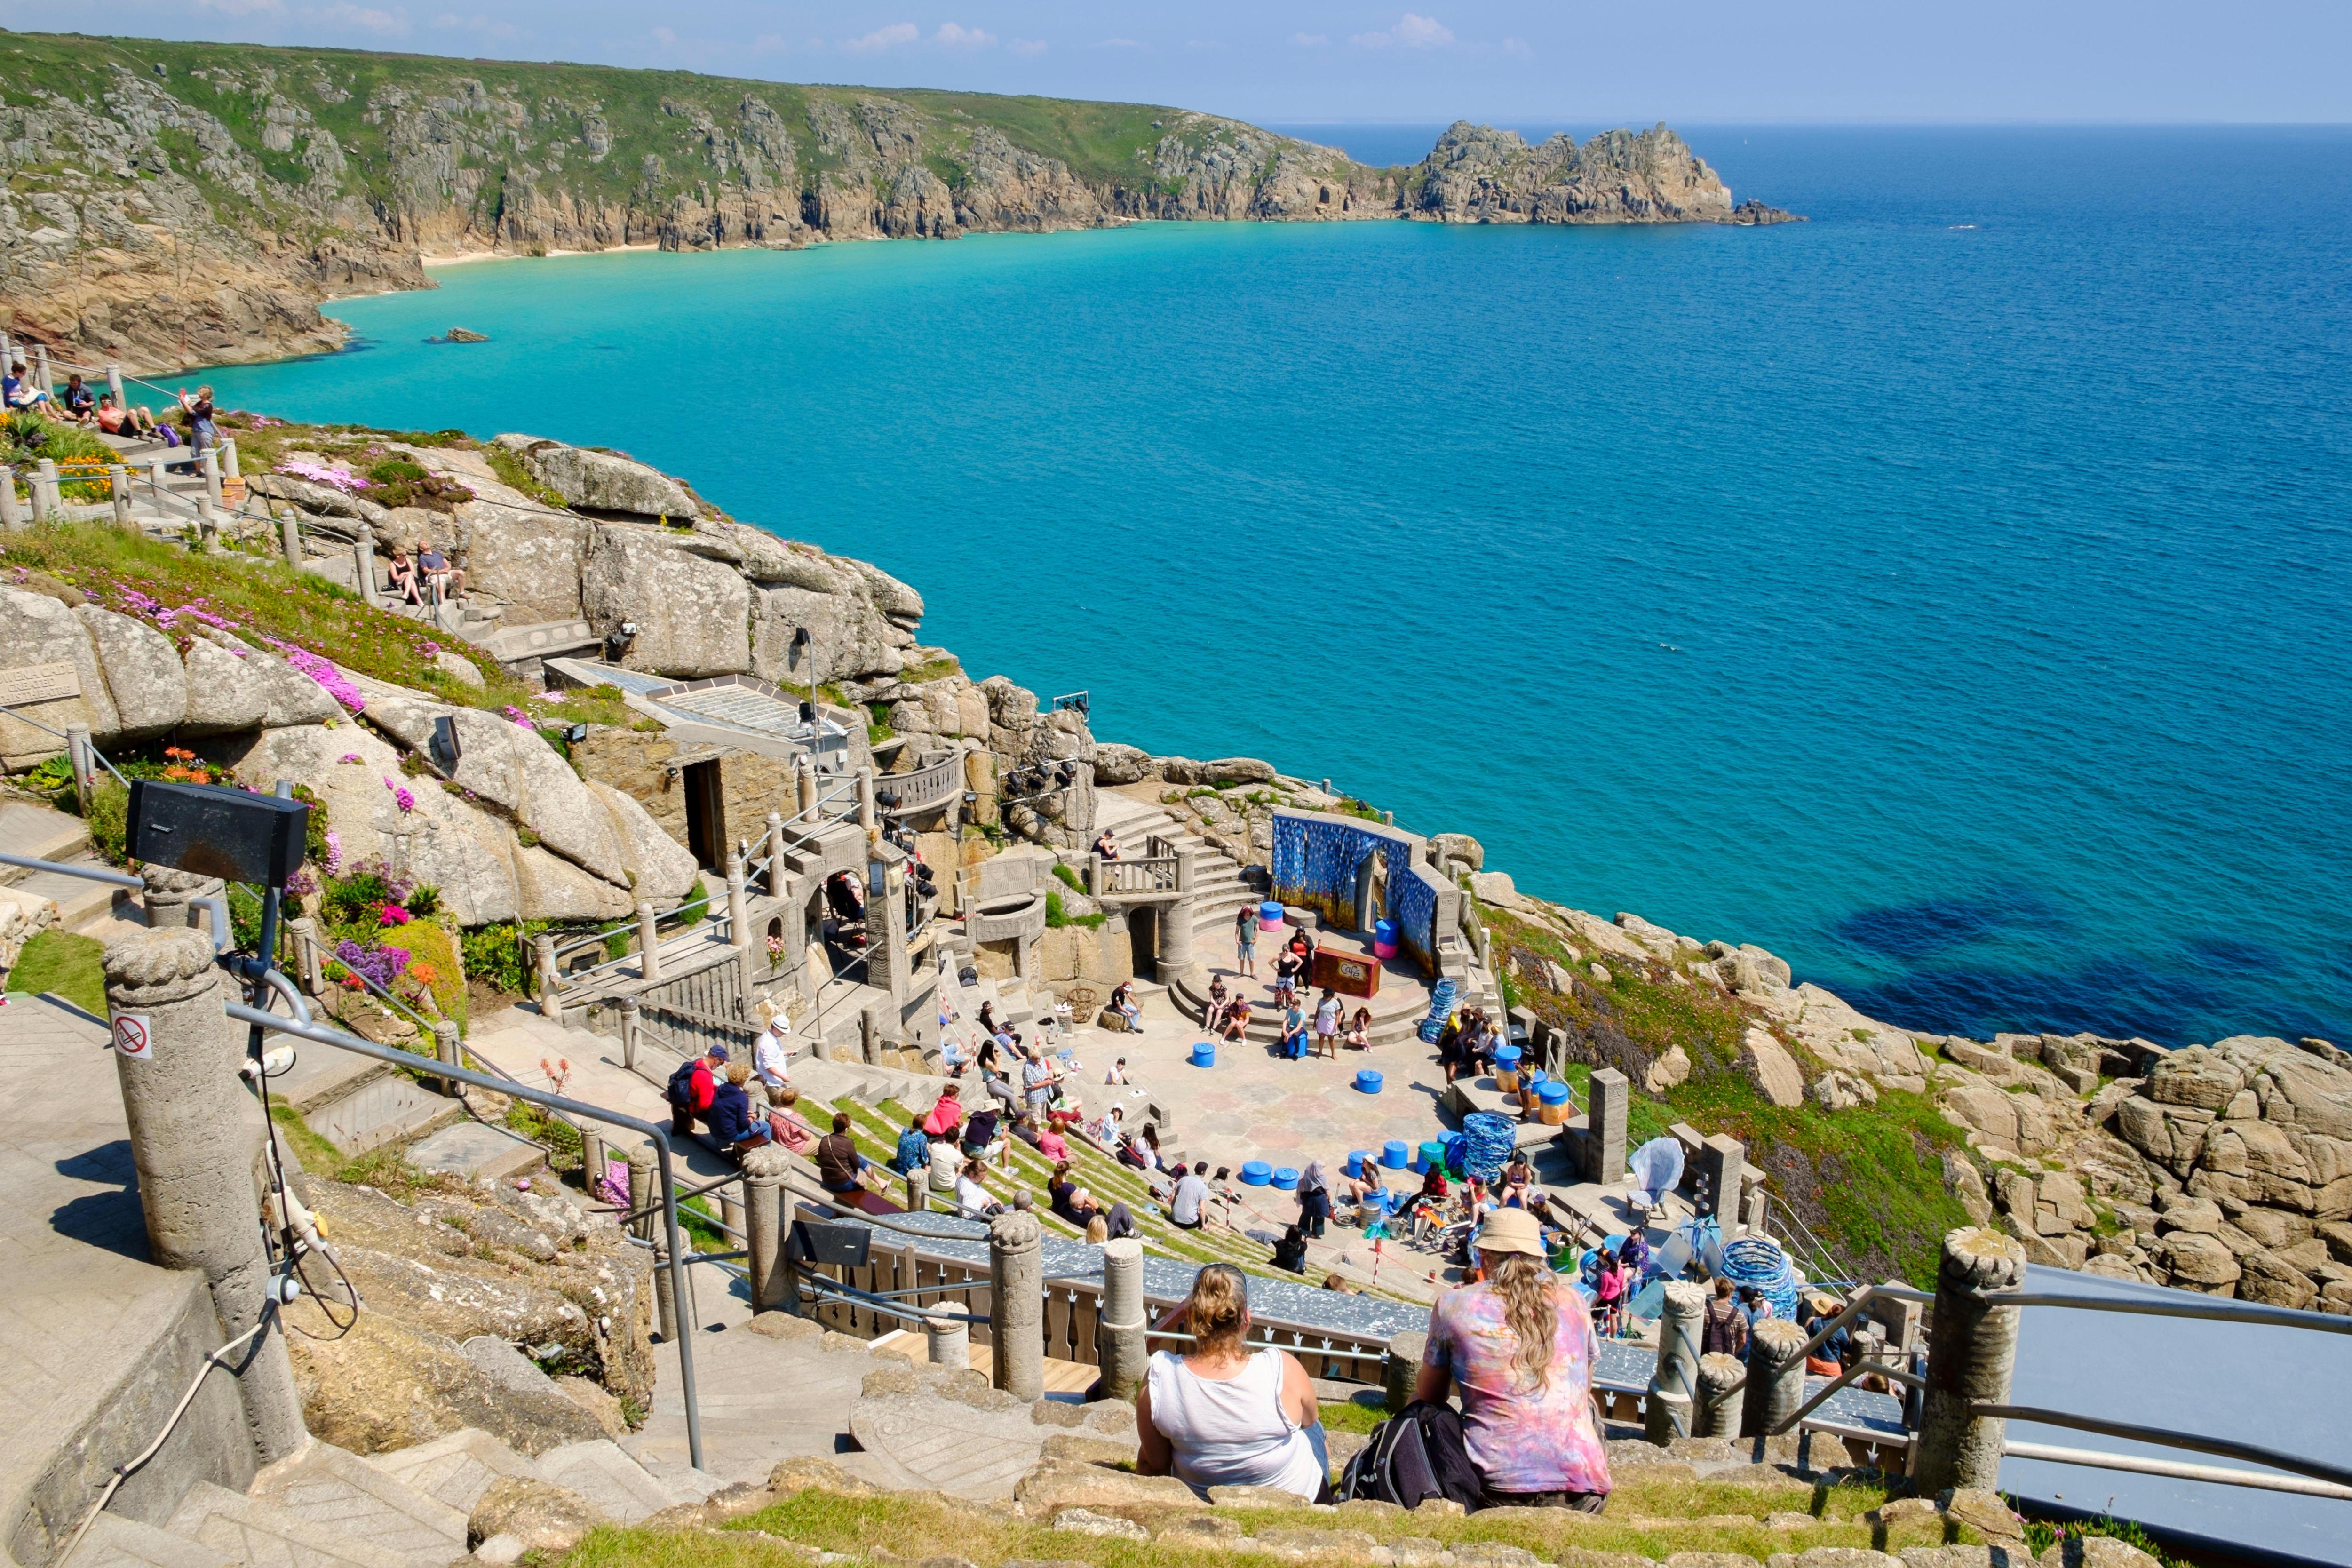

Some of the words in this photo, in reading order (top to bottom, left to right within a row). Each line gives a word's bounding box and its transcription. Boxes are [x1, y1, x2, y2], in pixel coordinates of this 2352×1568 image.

[41, 664, 74, 677] CADE
[8, 678, 56, 692] CREATED
[22, 685, 71, 700] THEATRE
[151, 824, 173, 833] BOSE
[1341, 963, 1360, 979] Café
